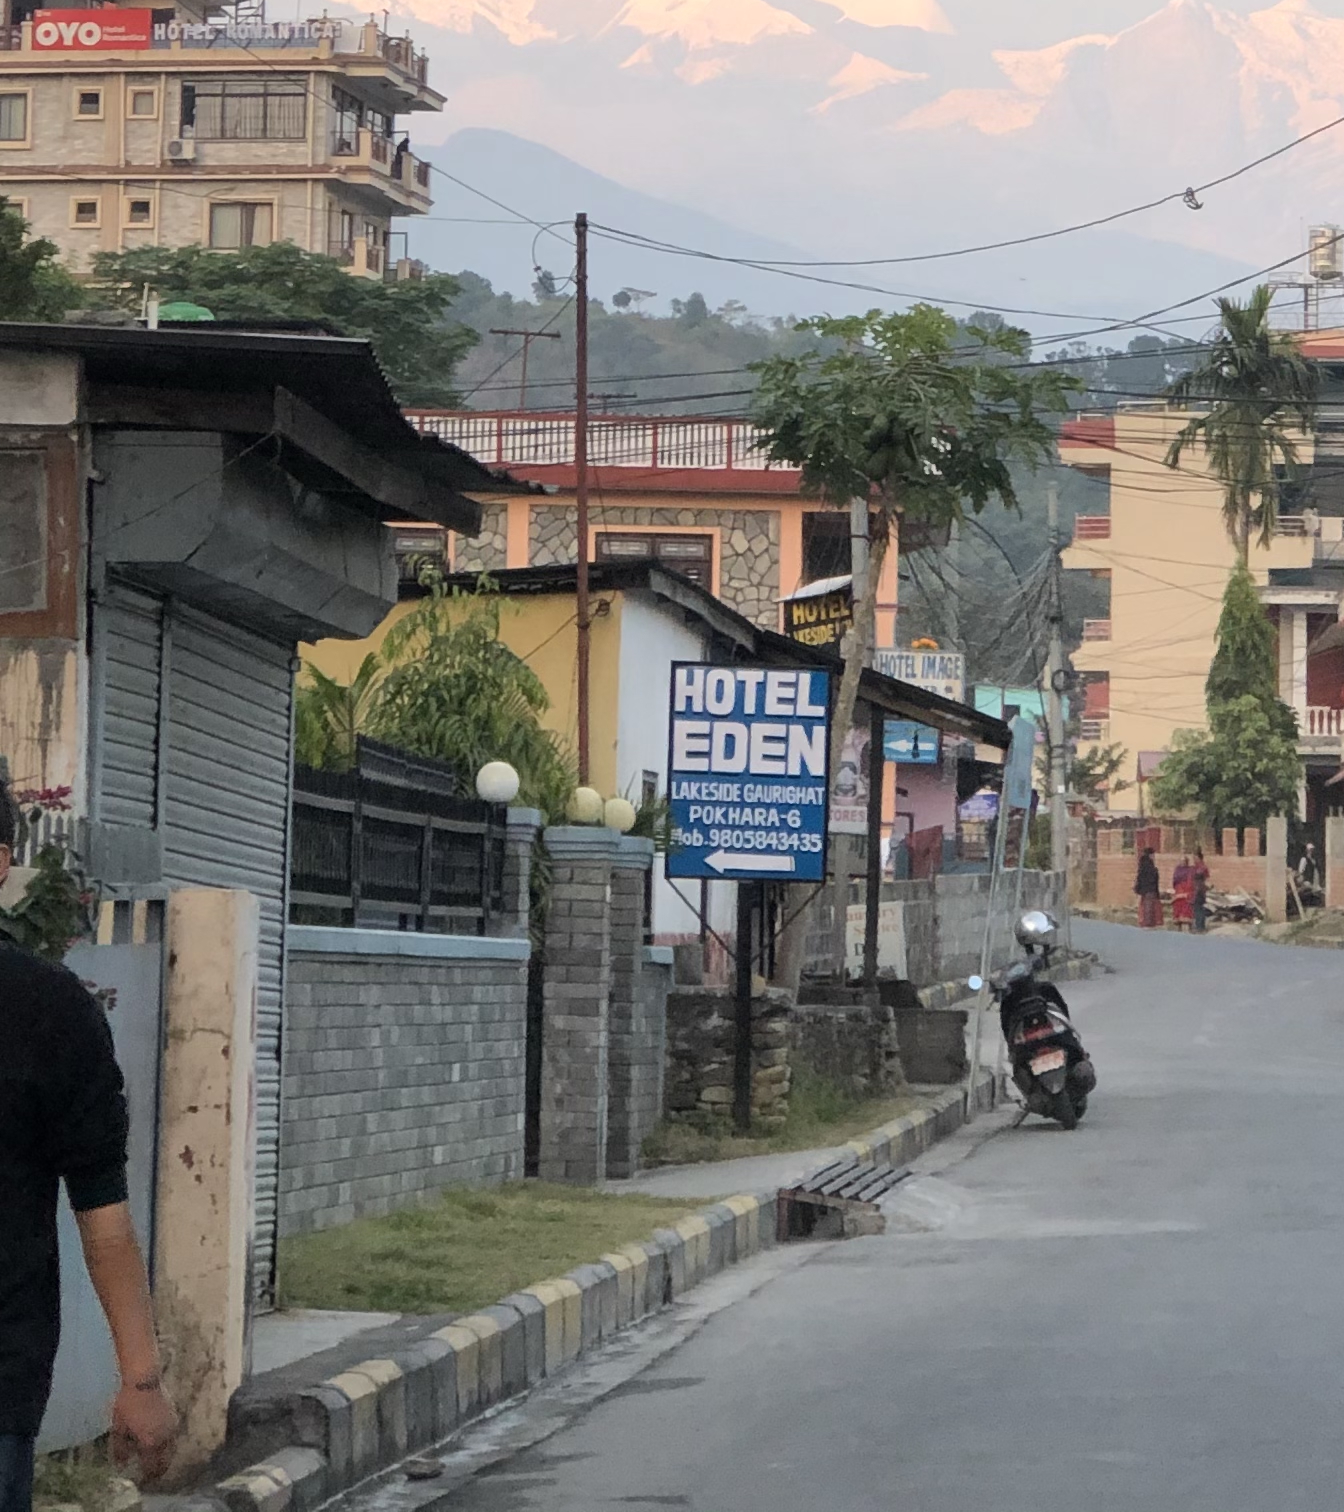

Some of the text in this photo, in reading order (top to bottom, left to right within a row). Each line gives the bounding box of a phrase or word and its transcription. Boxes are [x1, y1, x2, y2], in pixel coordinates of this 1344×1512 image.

[36, 21, 102, 46] OYO
[153, 22, 216, 40] HOTEL
[792, 595, 851, 626] HOTEL
[879, 653, 960, 680] HOTEL IMAGE
[673, 667, 826, 717] HOTEL
[672, 719, 826, 777] EDEN
[671, 781, 825, 806] LAKESIDE GAURIGHAT
[689, 805, 801, 828] POKHARA-6
